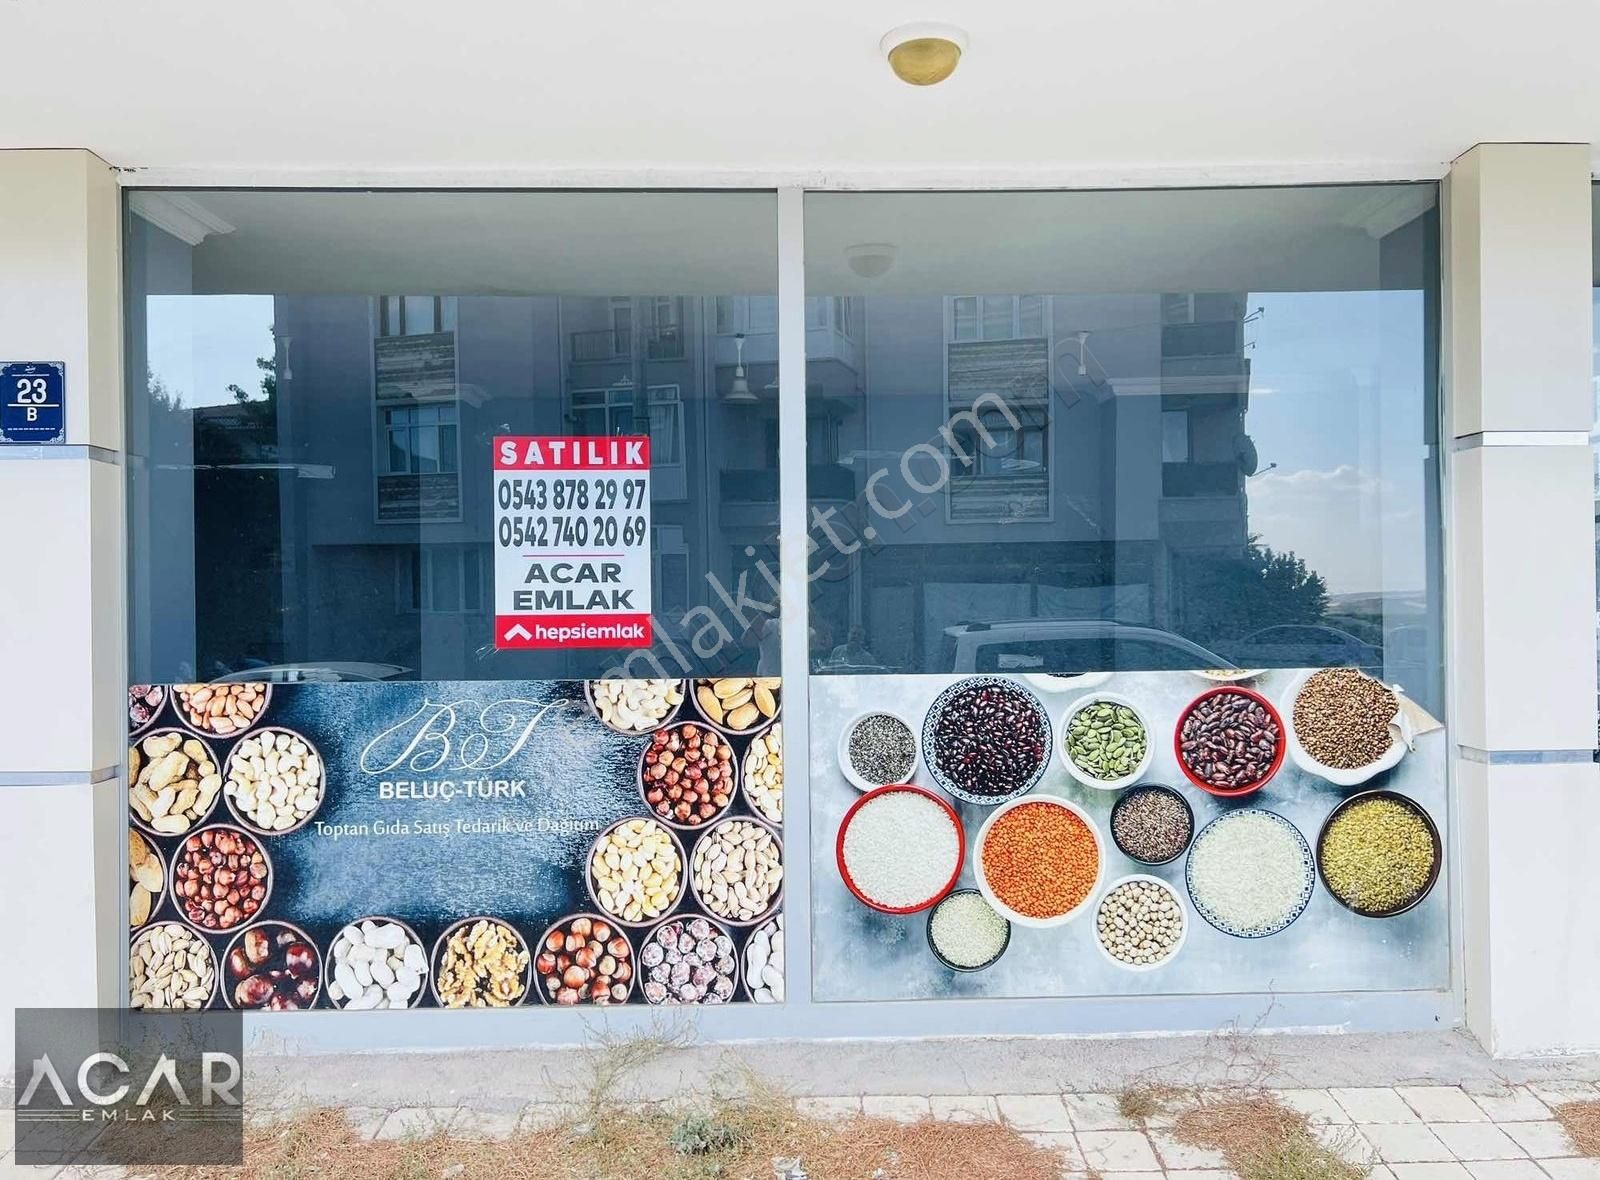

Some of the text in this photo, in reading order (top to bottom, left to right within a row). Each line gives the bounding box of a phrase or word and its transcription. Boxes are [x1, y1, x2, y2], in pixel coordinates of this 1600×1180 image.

[16, 378, 48, 404] 23
[26, 407, 38, 422] B
[500, 440, 644, 465] SATILIK
[498, 479, 646, 510] 0543 878 29 97
[499, 516, 647, 547] 0542 740 20 69
[524, 562, 622, 583] ACAR
[513, 589, 635, 611] EMLAK
[535, 622, 645, 643] hepsiemlak
[379, 776, 526, 802] BELUÇ-TÜRK
[314, 820, 369, 841] Toptan
[373, 818, 409, 836] Gıda
[413, 819, 450, 838] Satış
[455, 817, 509, 834] Tedarik
[514, 820, 534, 832] ve
